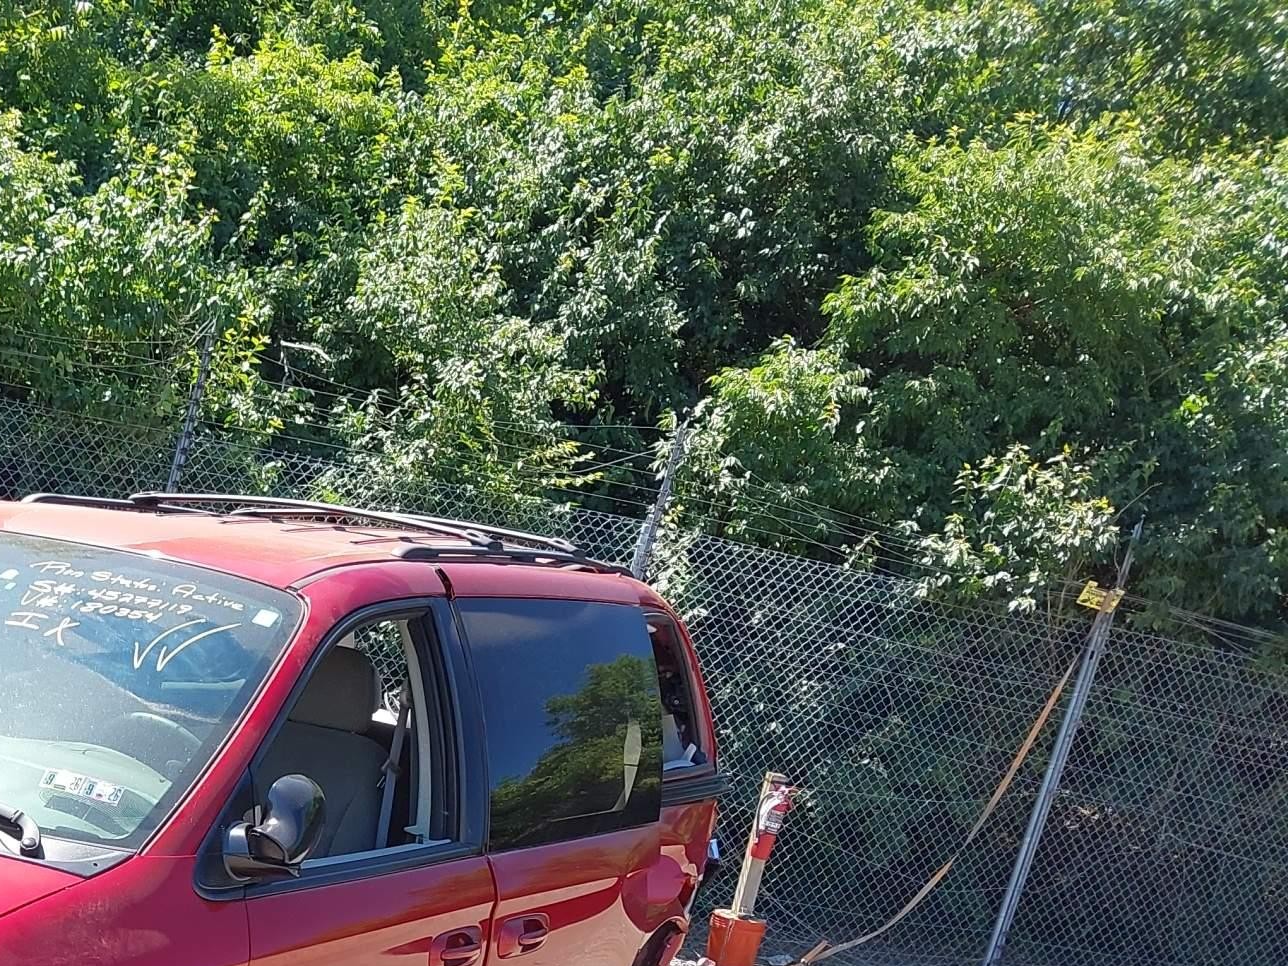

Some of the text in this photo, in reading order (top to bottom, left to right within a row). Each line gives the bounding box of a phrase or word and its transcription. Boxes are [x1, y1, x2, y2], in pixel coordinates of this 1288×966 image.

[87, 588, 193, 615] 45277119
[171, 583, 244, 611] Active
[70, 600, 163, 623] 180354
